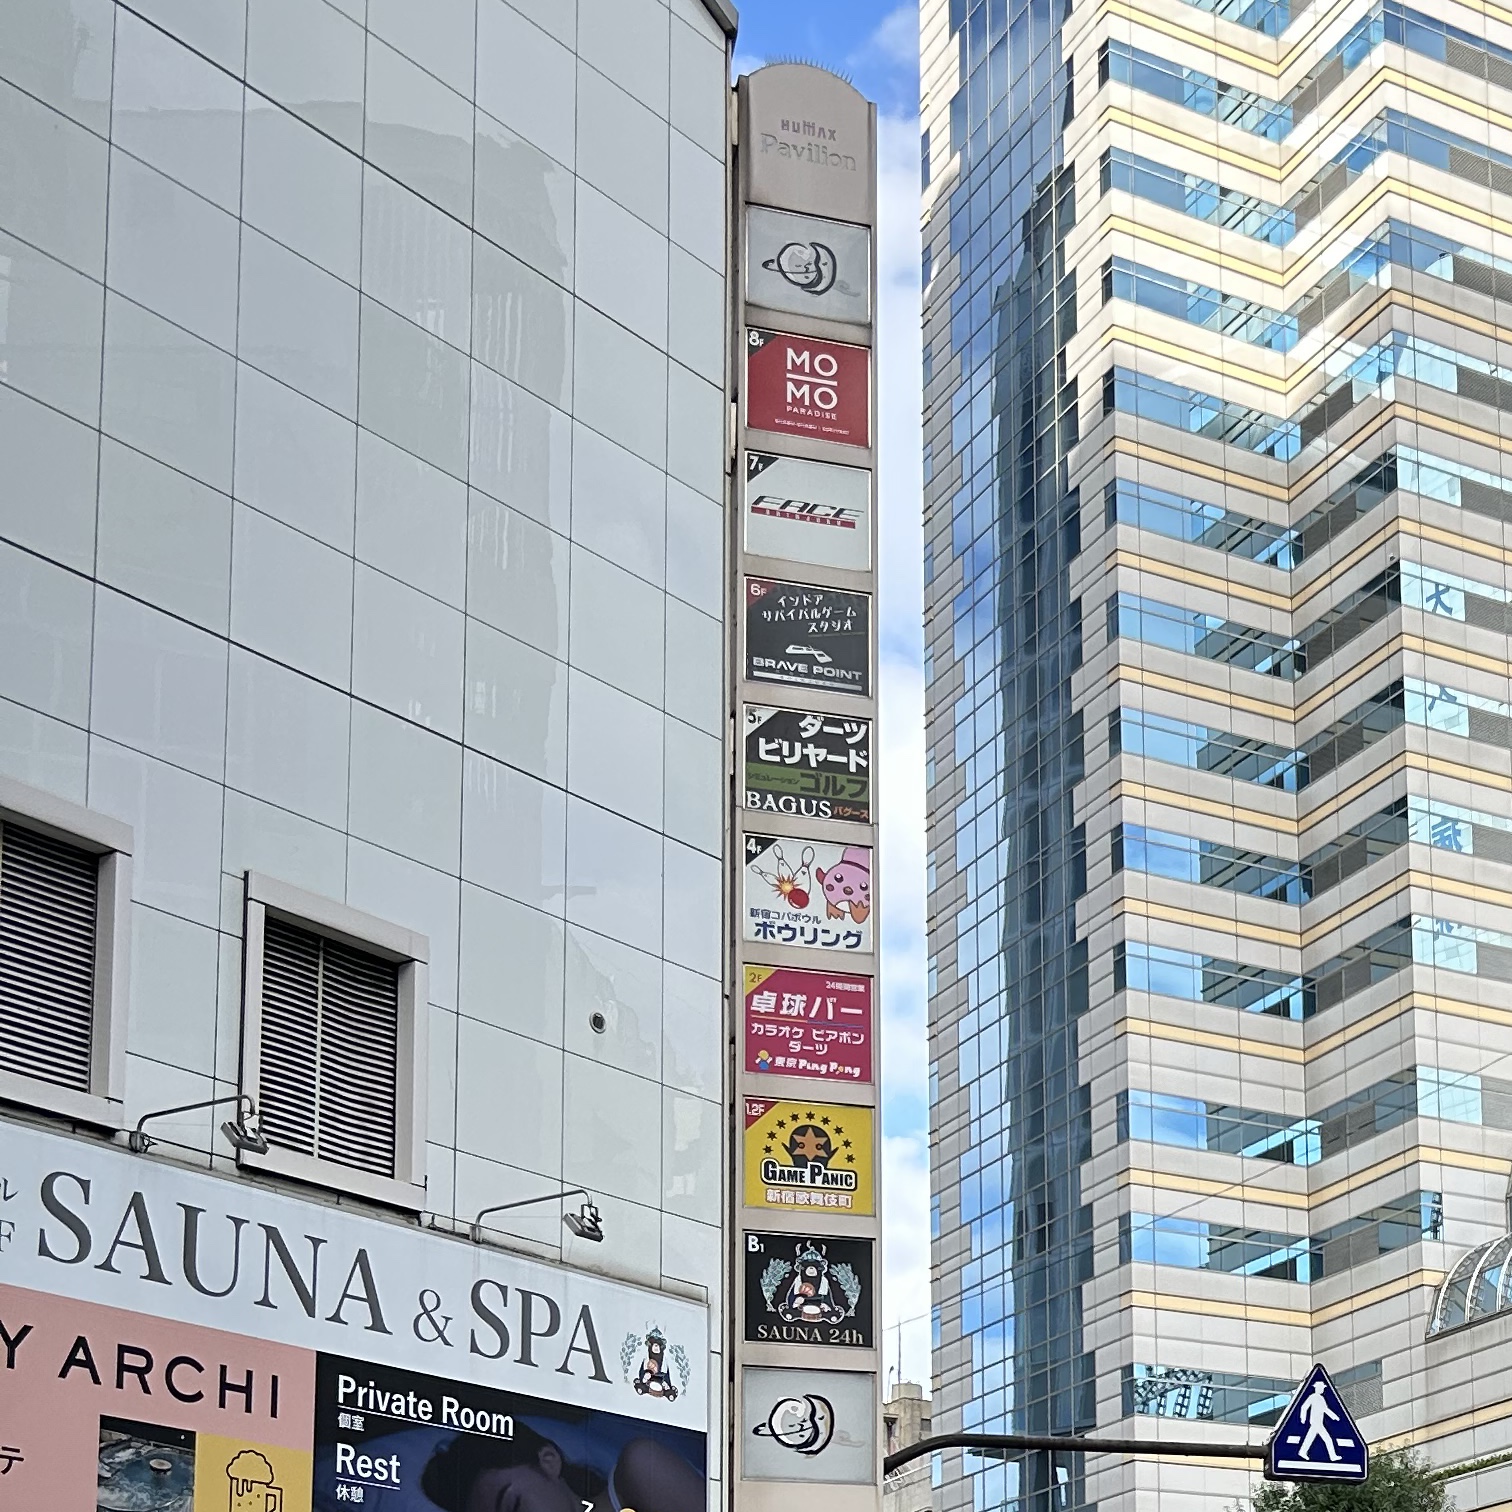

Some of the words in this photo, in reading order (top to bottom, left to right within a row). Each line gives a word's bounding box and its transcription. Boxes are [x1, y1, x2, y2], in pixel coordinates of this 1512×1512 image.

[760, 132, 857, 171] Pavilion
[786, 347, 838, 377] MO
[786, 381, 838, 410] MO
[786, 405, 838, 421] PARADISE
[749, 455, 764, 472] 7F
[751, 495, 865, 521] FACE
[750, 584, 767, 597] 6F
[777, 593, 824, 608] インドア
[752, 656, 809, 674] BRAVE
[812, 665, 863, 681] POINT
[798, 715, 868, 745] ダーツ
[758, 737, 869, 773] ビリヤード
[746, 790, 832, 819] BAGUS
[746, 838, 762, 855] 4F
[754, 921, 863, 949] ボウリング
[750, 990, 863, 1020] 卓球バー
[750, 1022, 805, 1039] カラオケ
[788, 1041, 828, 1055] ダーツ
[766, 1189, 853, 1209] 新宿歌舞伎町
[747, 1235, 765, 1253] B1
[38, 1171, 393, 1335] SAUNA
[412, 1288, 455, 1348] &
[469, 1278, 614, 1385] SPA
[757, 1324, 823, 1342] SAUNA
[829, 1328, 864, 1345] 24h
[58, 1335, 279, 1419] ARCHI
[337, 1374, 433, 1421] Private
[442, 1395, 515, 1437] Room
[337, 1412, 365, 1432] 個室
[335, 1442, 400, 1485] Rest
